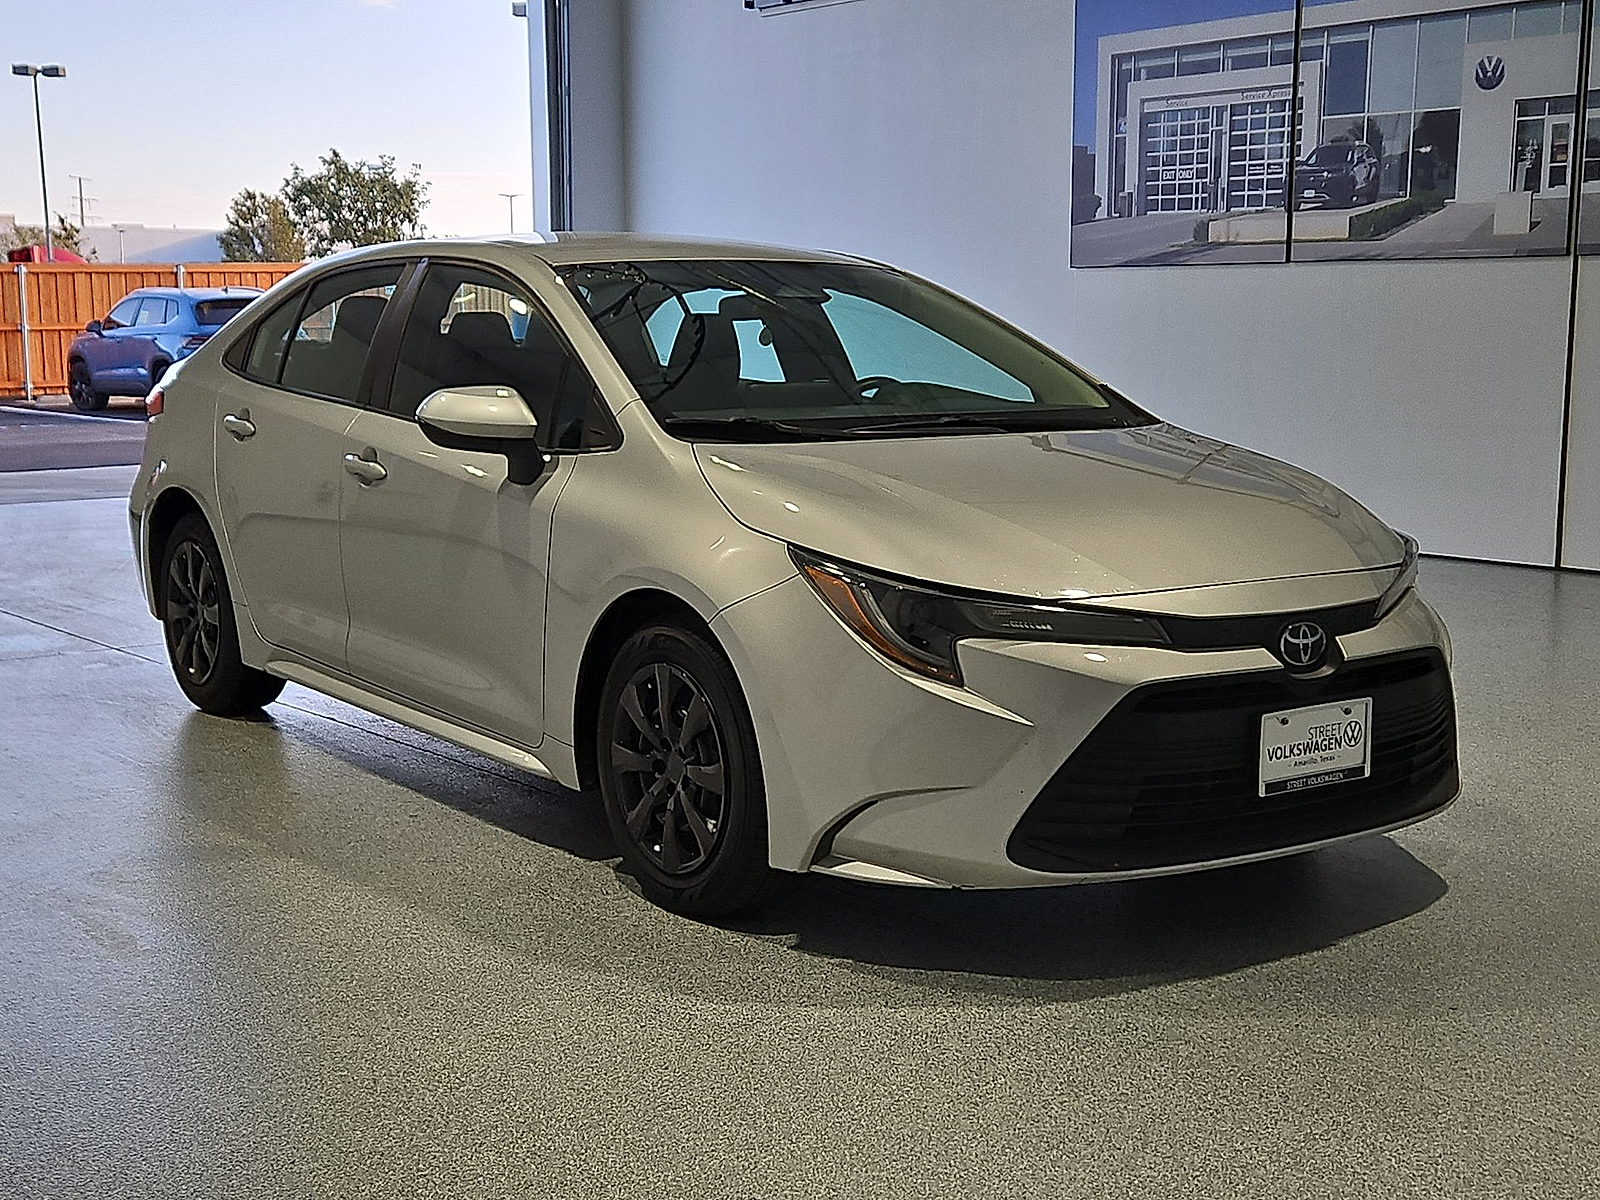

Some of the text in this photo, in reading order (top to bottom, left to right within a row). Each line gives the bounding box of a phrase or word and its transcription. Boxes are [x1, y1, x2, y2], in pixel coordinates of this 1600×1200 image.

[1241, 91, 1266, 100] Service
[1163, 169, 1194, 180] EXIT ONLY
[1308, 722, 1343, 740] STREET
[1267, 736, 1342, 761] VOLKSWAGEN
[1287, 772, 1343, 789] STREET VOLKSWAGEN
